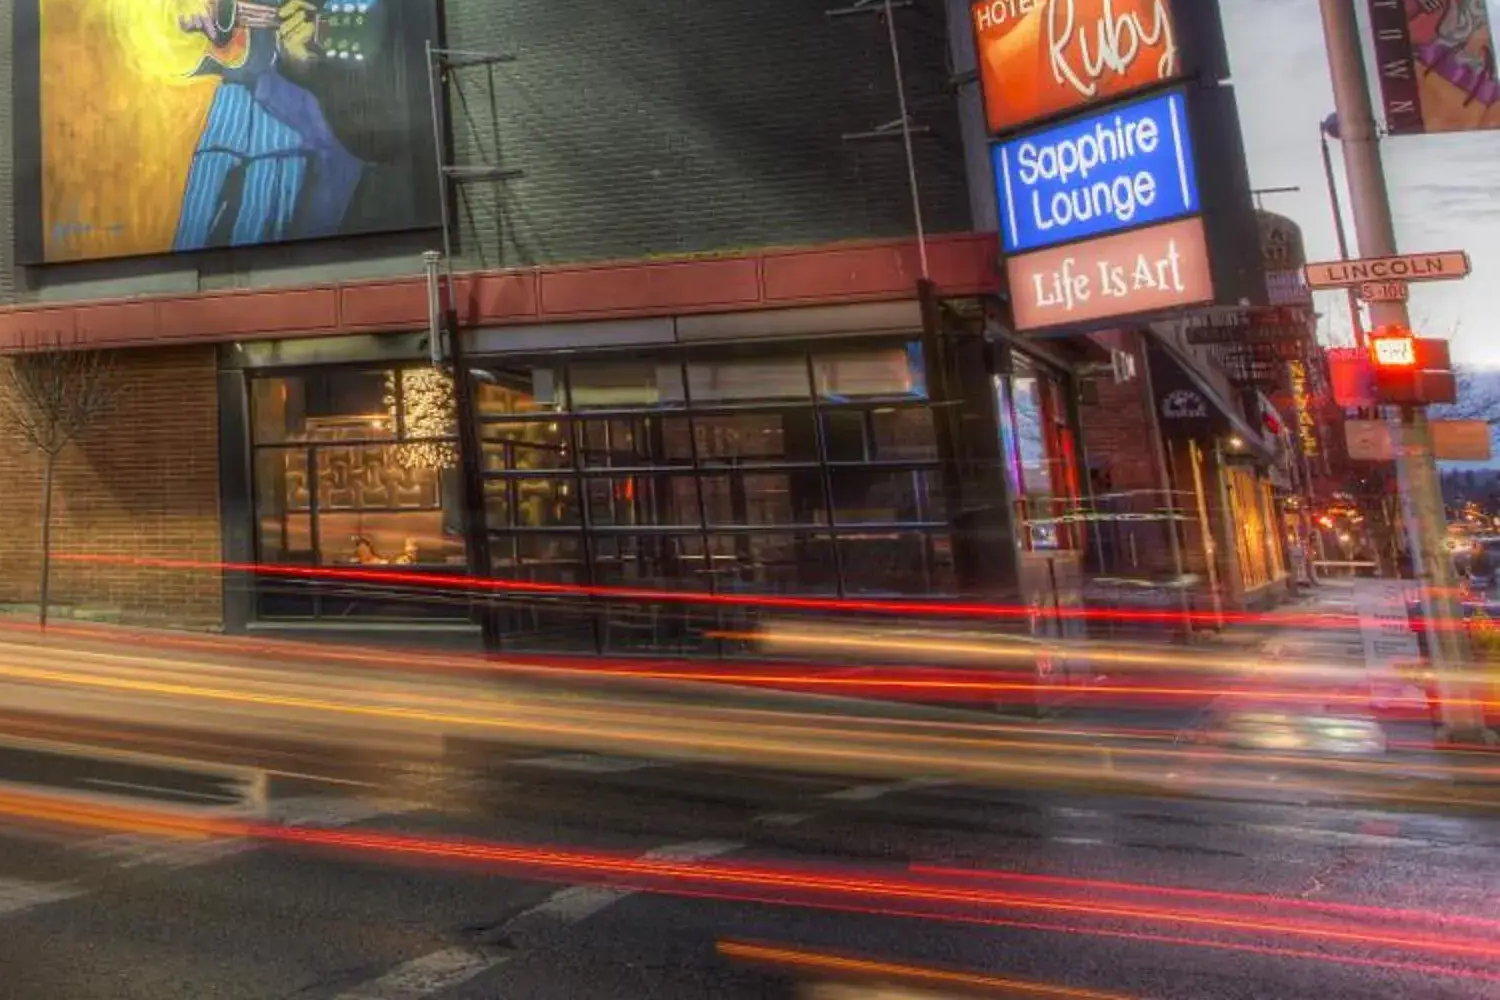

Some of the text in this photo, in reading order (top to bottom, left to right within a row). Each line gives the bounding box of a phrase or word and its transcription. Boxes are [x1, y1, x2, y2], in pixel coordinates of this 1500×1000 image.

[1017, 115, 1159, 185] Sapphire
[1031, 170, 1157, 231] Lounge
[1032, 239, 1185, 311] Life Is Art
[1328, 258, 1443, 280] LINCOLN
